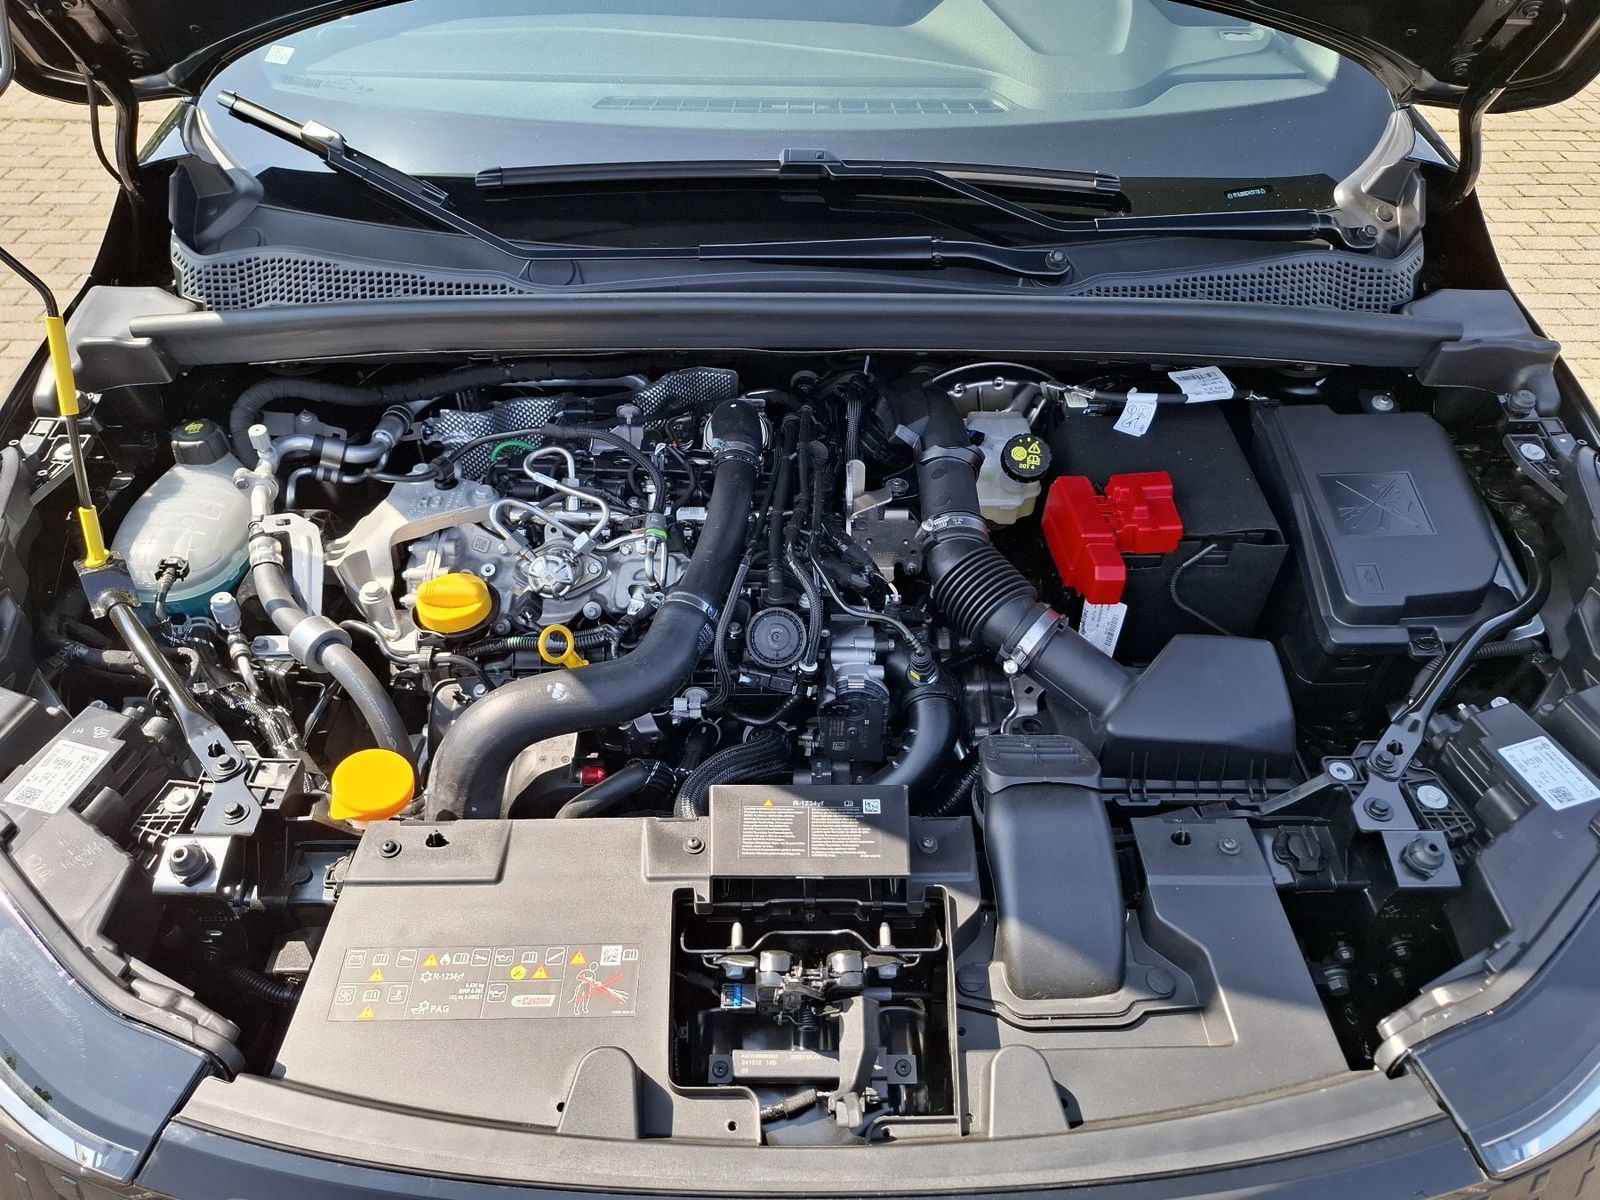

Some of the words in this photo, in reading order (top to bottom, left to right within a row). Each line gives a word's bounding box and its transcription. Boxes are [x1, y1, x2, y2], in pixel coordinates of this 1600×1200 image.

[792, 800, 825, 808] R-1234yf
[433, 972, 465, 982] R-1234yf
[521, 996, 551, 1006] Castrol
[430, 1004, 450, 1013] PAG
